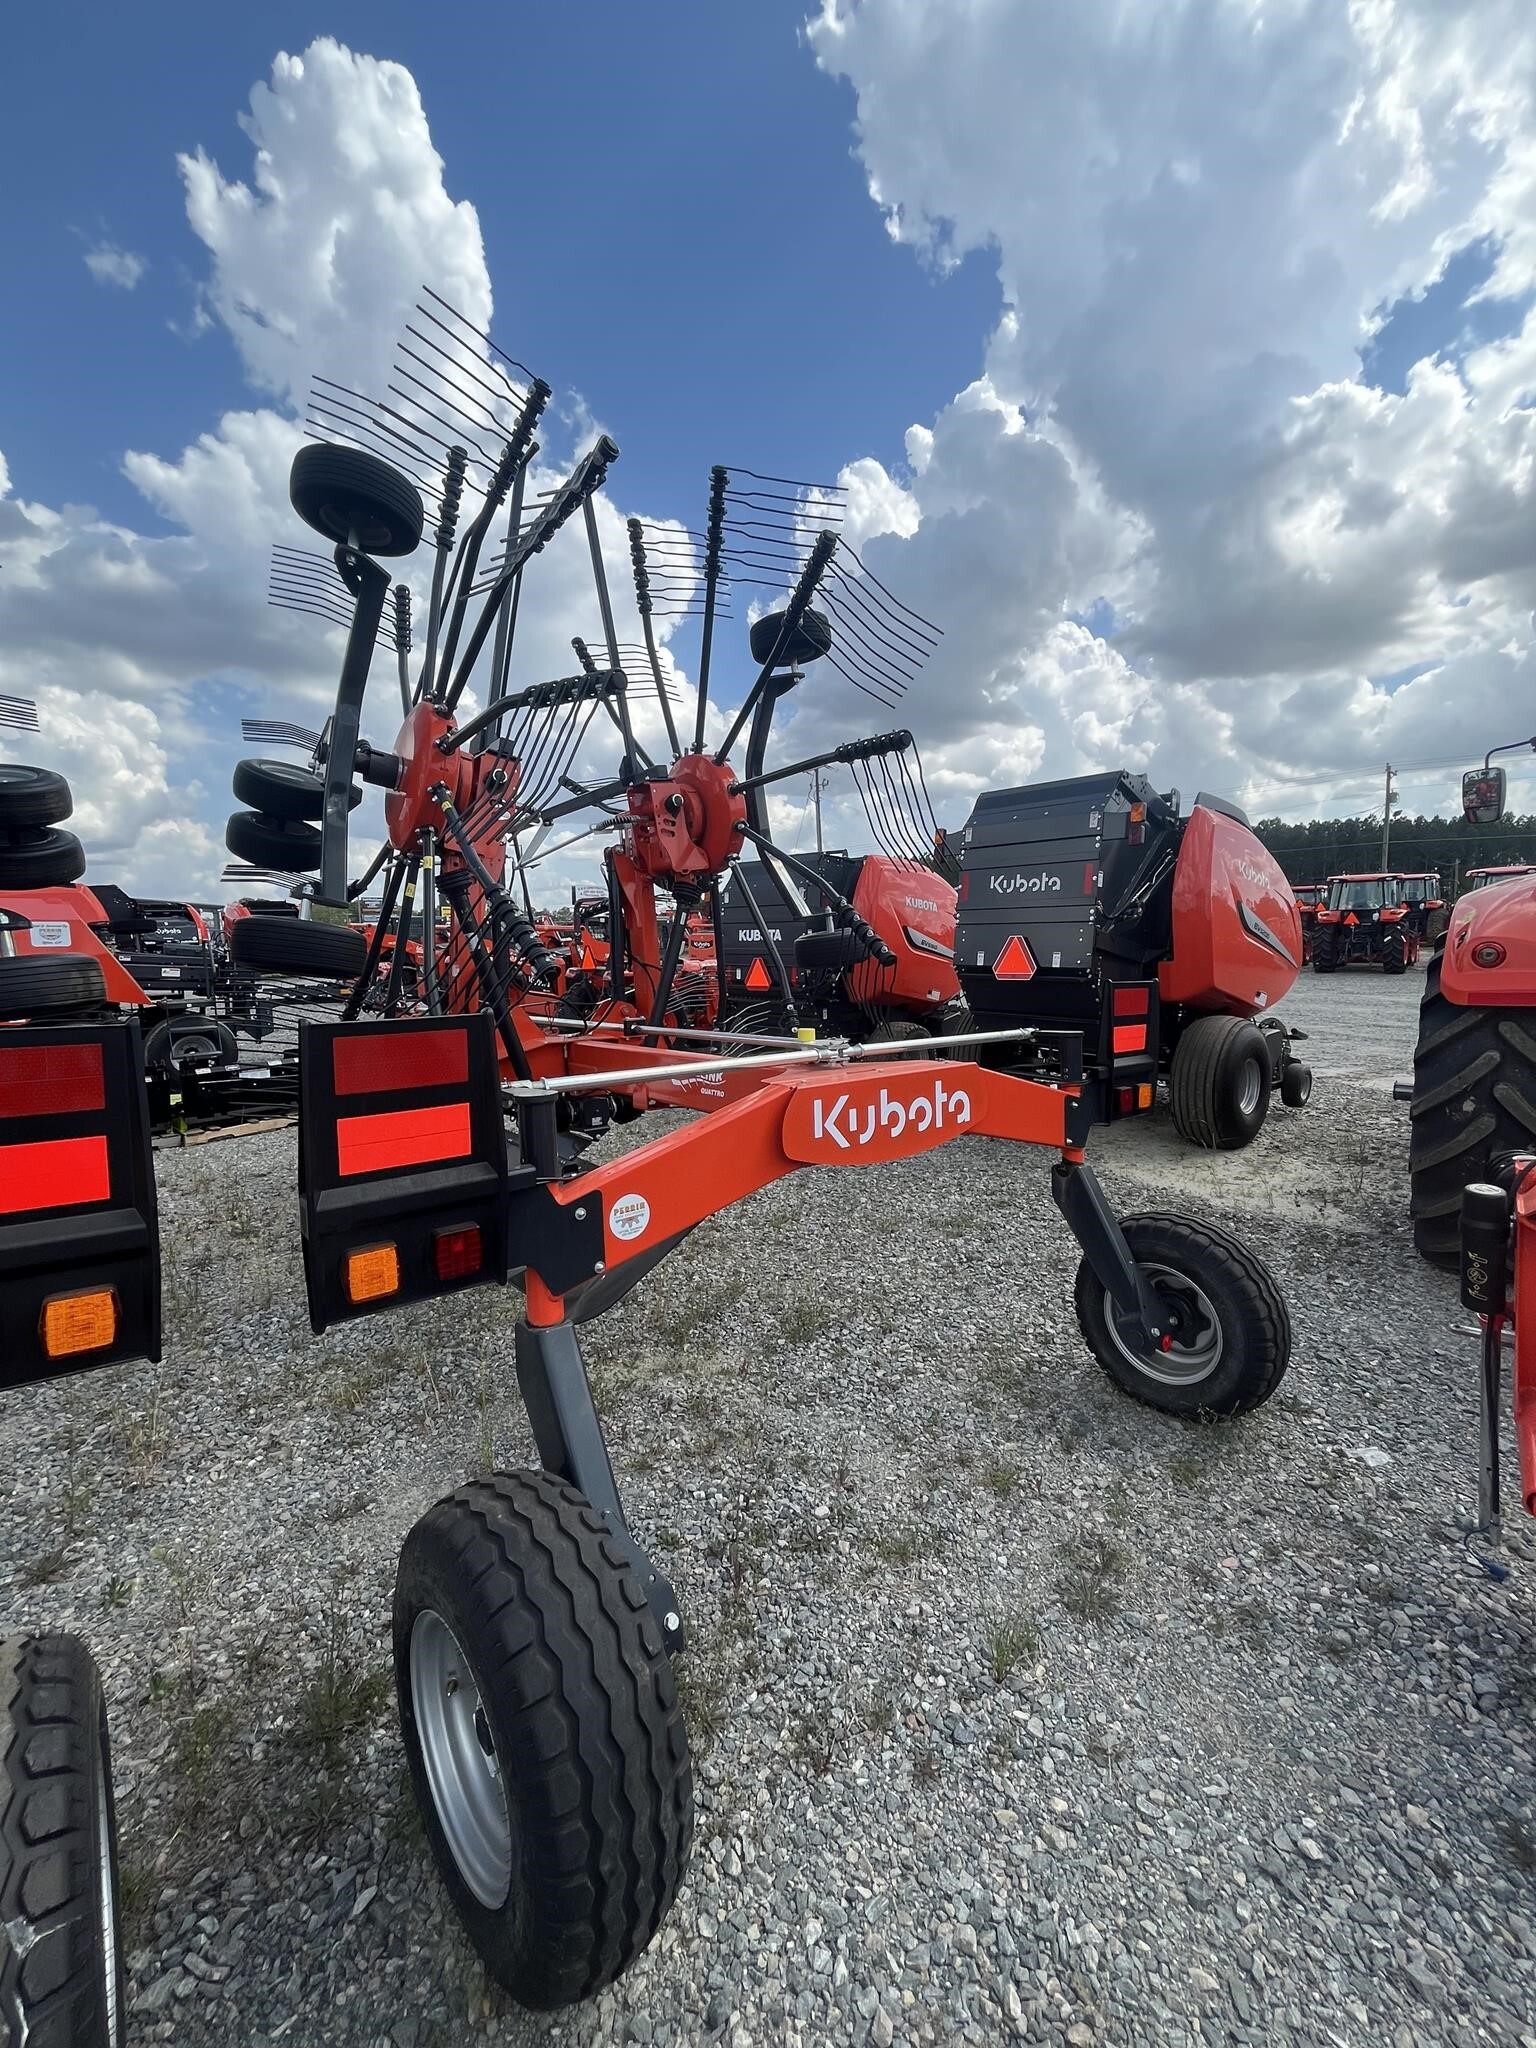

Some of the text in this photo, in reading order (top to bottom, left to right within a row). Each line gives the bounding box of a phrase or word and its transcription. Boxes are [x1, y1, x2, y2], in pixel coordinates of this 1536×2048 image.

[990, 872, 1061, 894] Kubota
[1239, 862, 1270, 889] Kubota
[905, 895, 938, 912] KUBOTA
[739, 929, 782, 941] KUBTA
[700, 1087, 725, 1098] QUATTRO
[813, 1080, 971, 1149] Kubota
